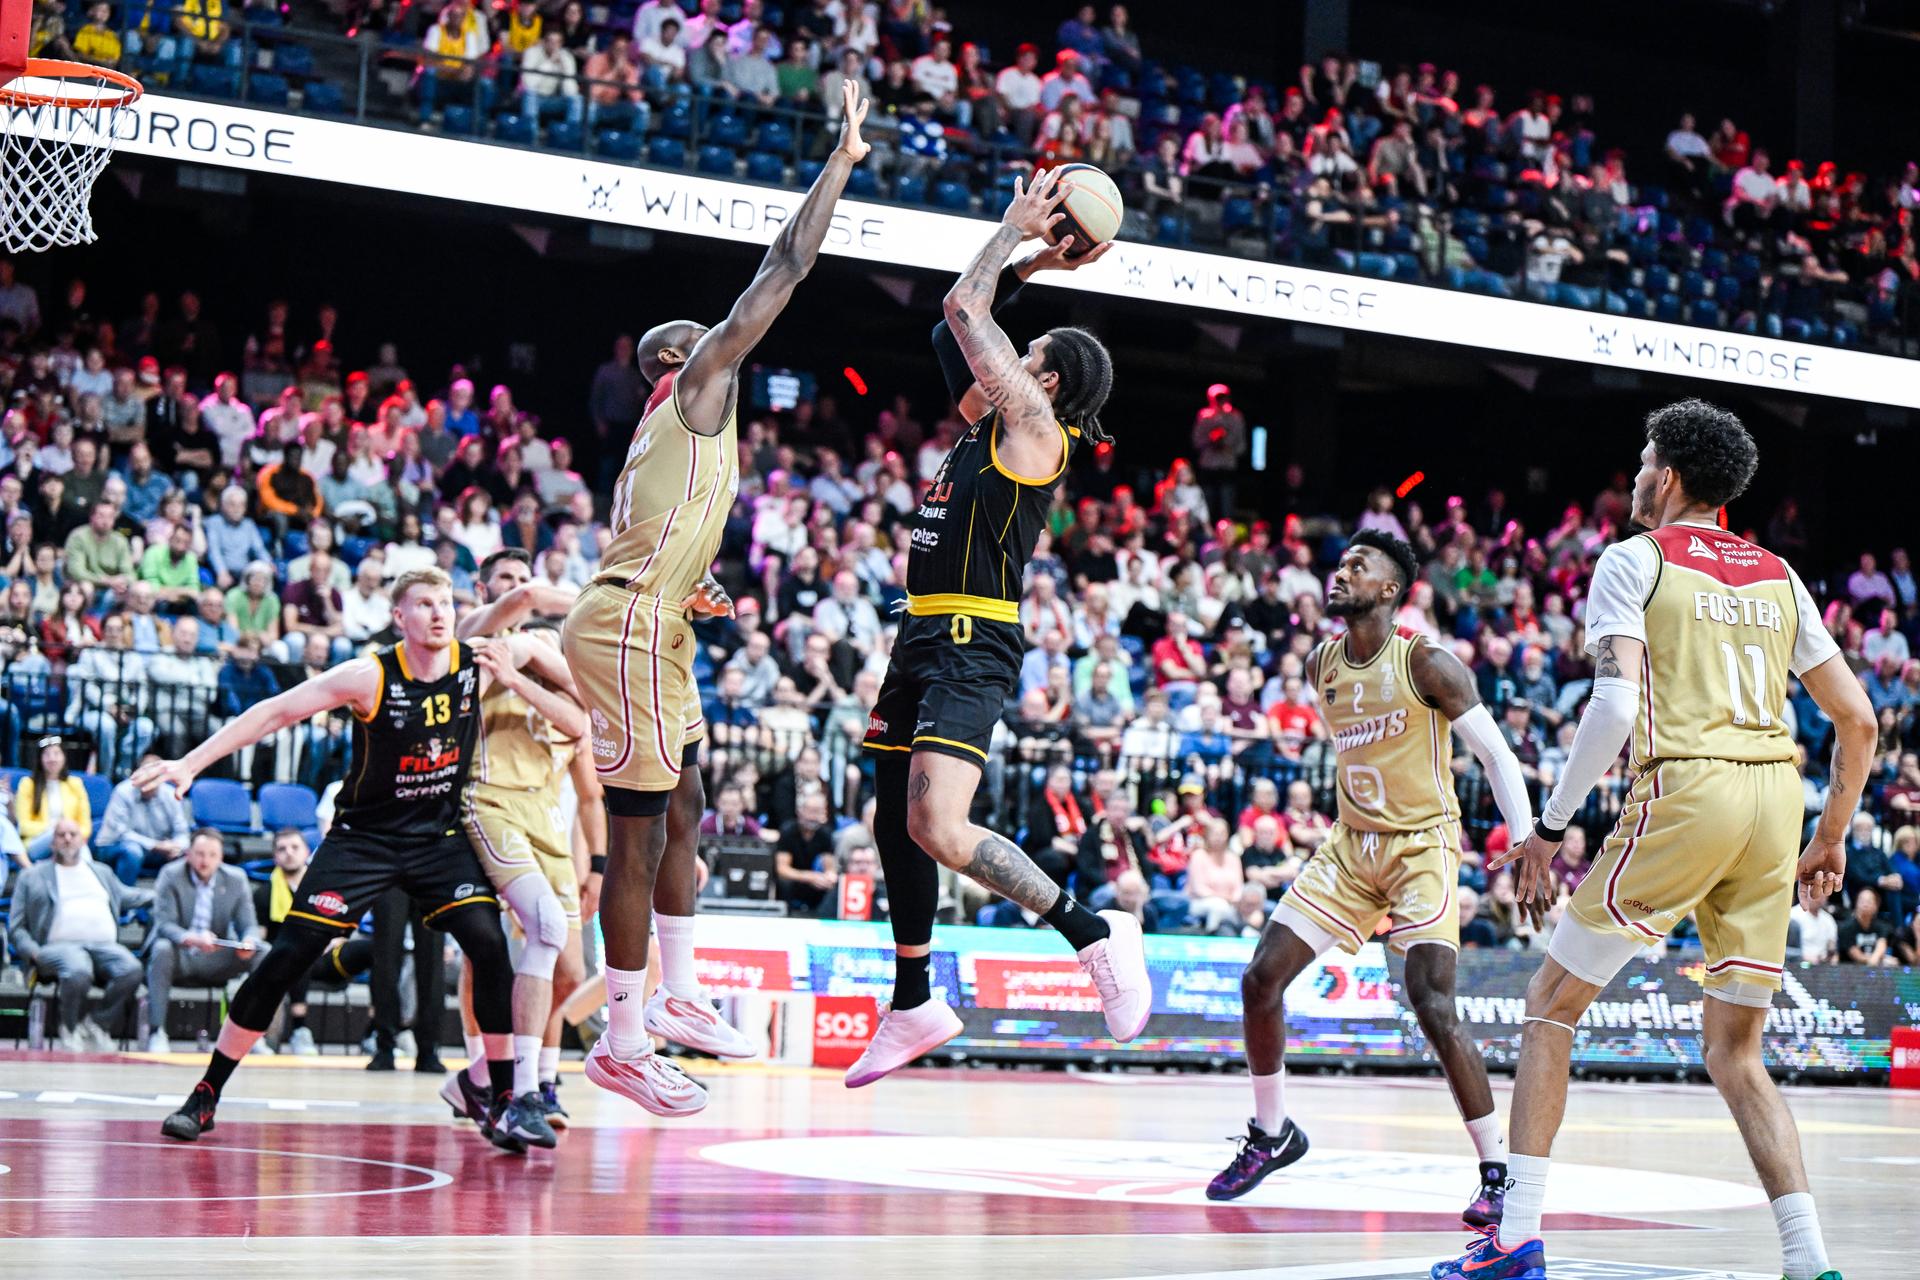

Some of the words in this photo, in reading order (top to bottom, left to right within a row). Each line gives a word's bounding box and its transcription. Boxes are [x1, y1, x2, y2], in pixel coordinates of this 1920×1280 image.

[641, 184, 885, 249] WINDRSE
[1169, 263, 1377, 319] WINDROSE
[1632, 333, 1813, 383] WINDROSE
[1714, 540, 1737, 549] Port
[1720, 548, 1763, 557] Antwerp
[1723, 555, 1759, 567] Bruges
[1693, 590, 1781, 632] FOSTER
[1353, 682, 1364, 714] 2
[1720, 640, 1771, 727] 11
[421, 693, 451, 727] 13
[847, 880, 867, 913] 5
[816, 1011, 869, 1038] SOS
